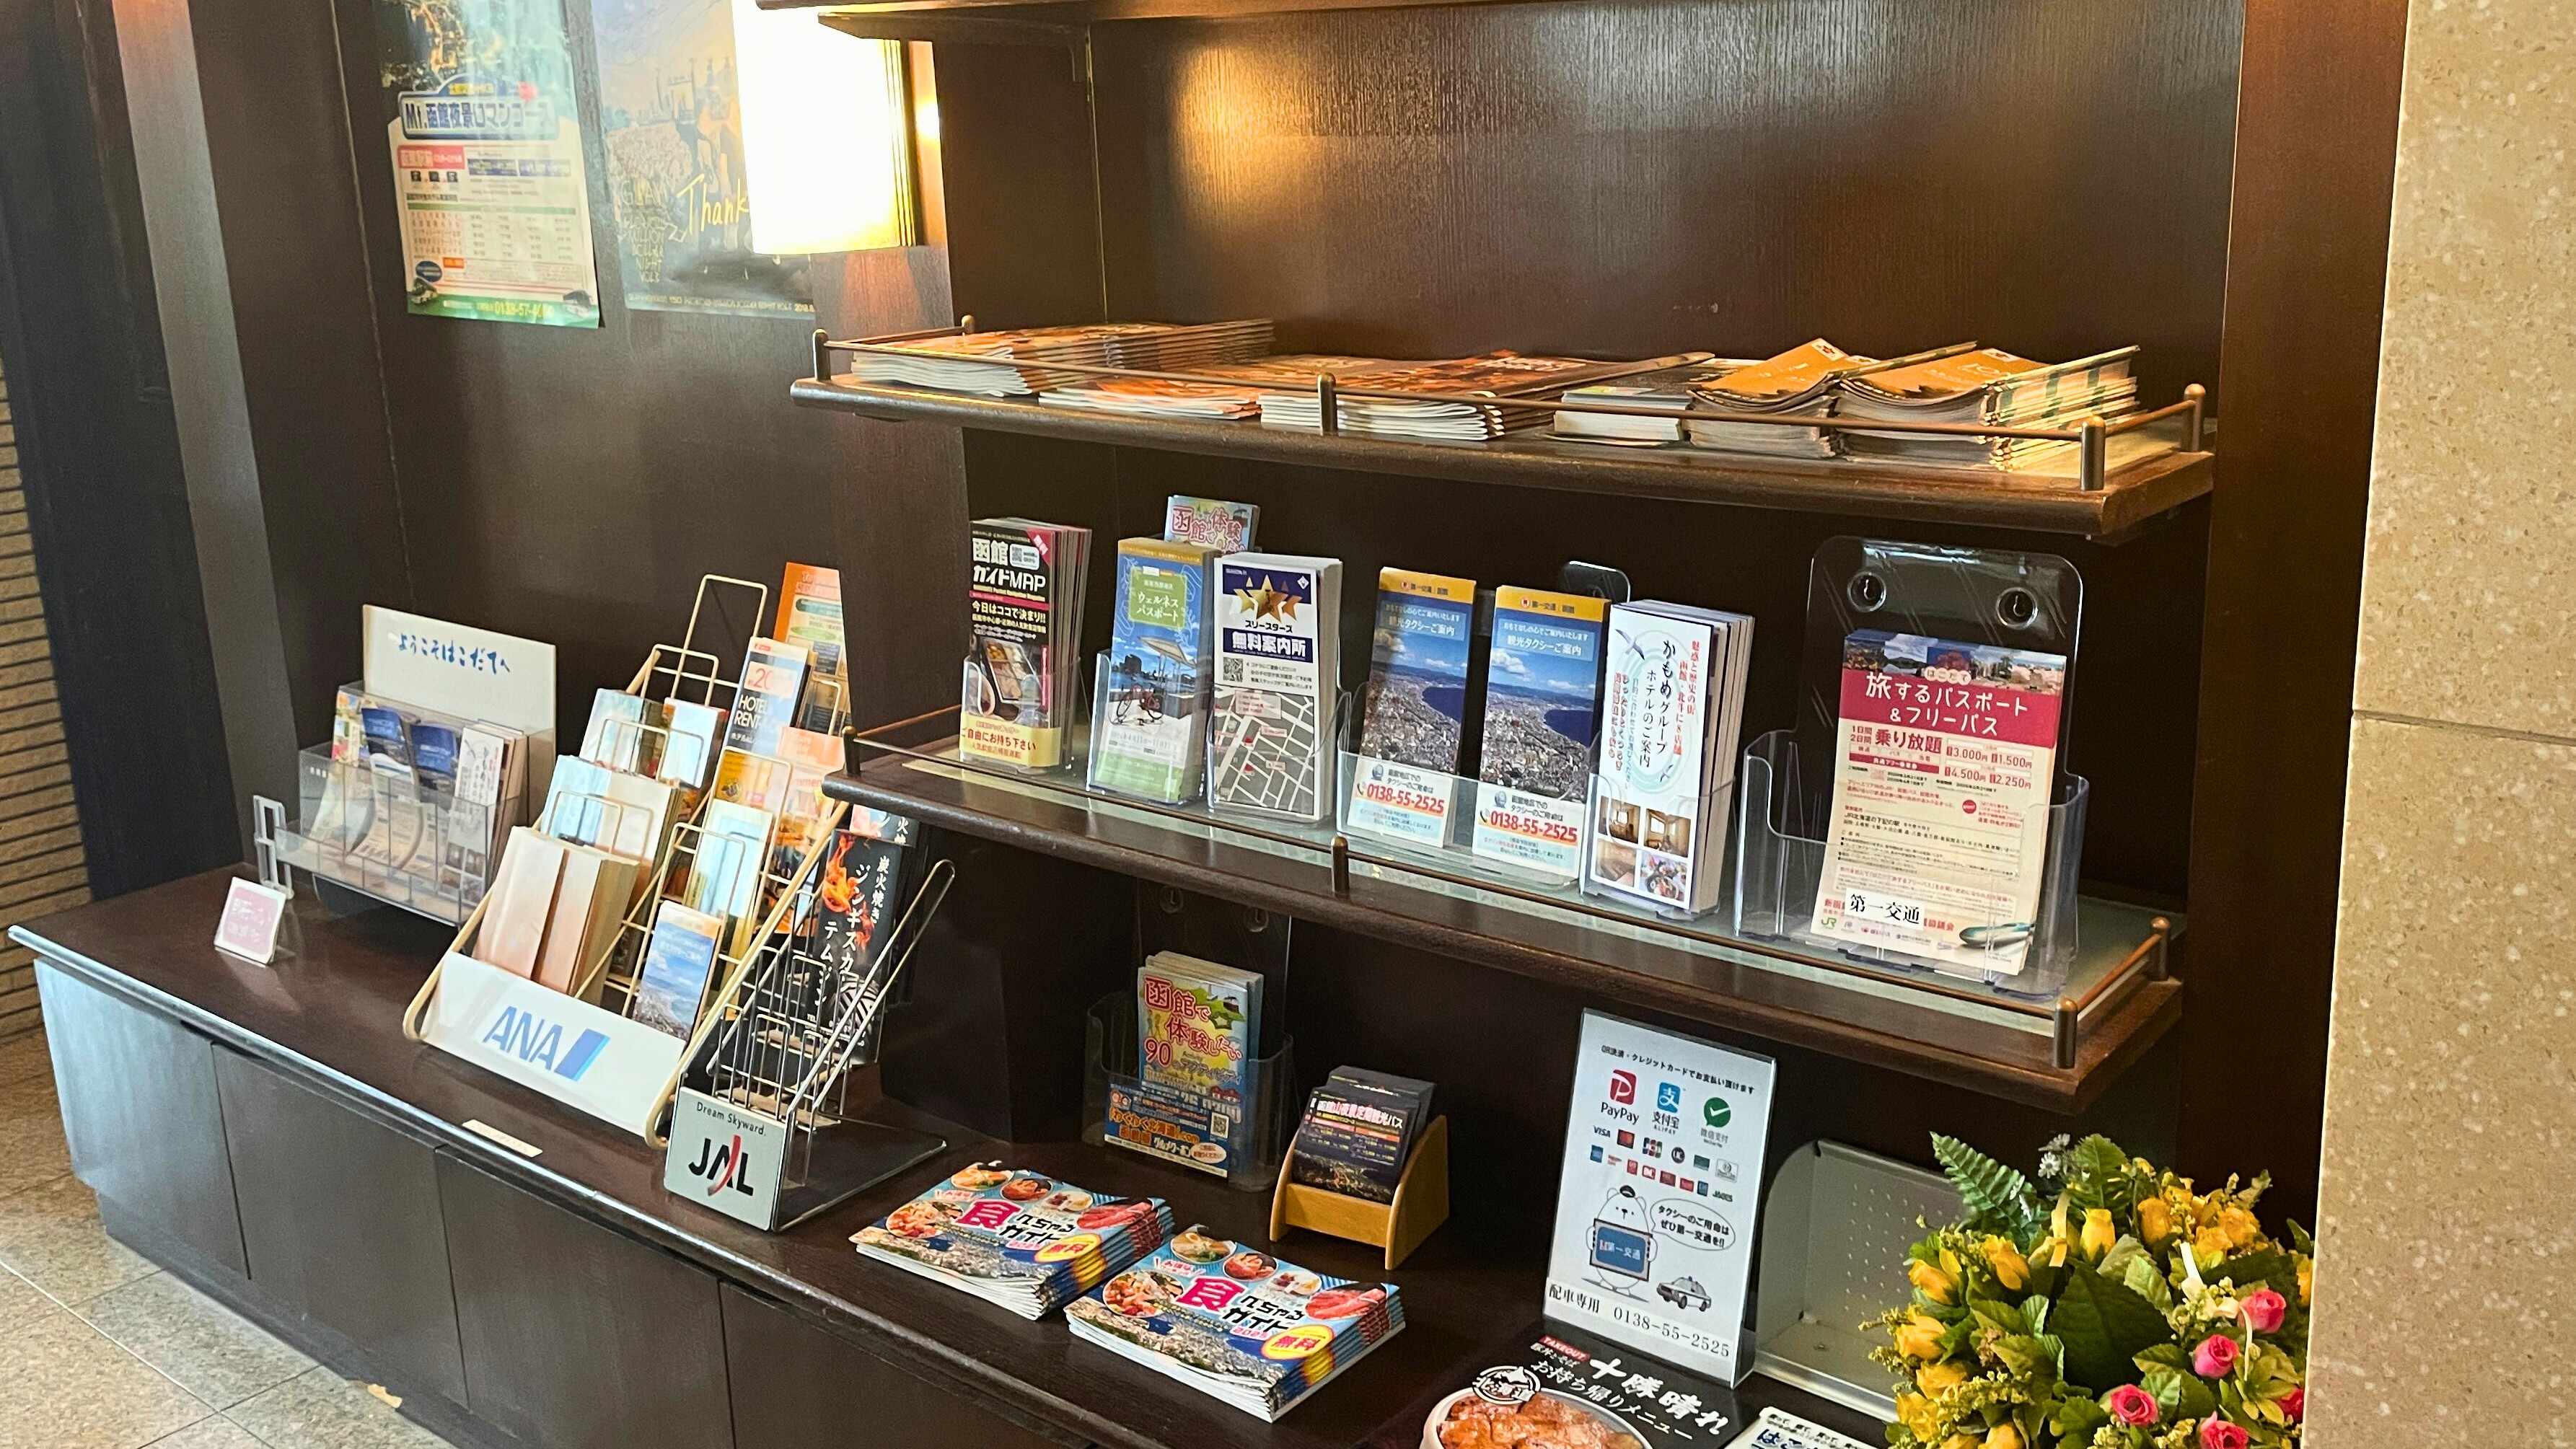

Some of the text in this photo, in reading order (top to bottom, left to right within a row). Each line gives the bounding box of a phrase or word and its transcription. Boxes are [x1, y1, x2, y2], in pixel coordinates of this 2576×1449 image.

[972, 537, 1008, 566] 函館
[973, 565, 1046, 592] ガイドMAP
[1137, 591, 1179, 608] ウェルネス
[1136, 607, 1179, 622] パスポート
[1245, 620, 1293, 633] スリースターズ
[1389, 615, 1455, 637] 観光タクシーご案内
[398, 633, 511, 675] ようこそはこだてへ
[1231, 631, 1306, 657] 無料案内所
[1507, 635, 1582, 656] 観光タクシーご案内
[1656, 639, 1676, 754] かもめグループ
[1865, 671, 2028, 717] 旅するパスポート
[1640, 669, 1657, 768] ホテルのご案内
[1889, 707, 1998, 736] &フリーパス
[961, 727, 1037, 752] ご自由にお持ち下さい
[1875, 728, 1943, 754] 乗り放題
[1366, 783, 1445, 814] 0138-55-2525
[1490, 810, 1578, 843] 0138-55-2525
[870, 855, 890, 925] 炭火焼き
[1850, 893, 1920, 926] 第一交通
[838, 863, 871, 994] ジンギスカン
[1143, 975, 1211, 1022] 函館で
[483, 1005, 560, 1075] ANA
[1143, 1036, 1174, 1068] 90
[696, 1101, 725, 1120] Dream
[1601, 1101, 1640, 1126] PayPay
[1651, 1110, 1680, 1130] 支付宝
[1593, 1124, 1612, 1138] VISA
[687, 1134, 755, 1197] JAL
[1549, 1283, 1730, 1358] 配車専用 0138-55-2525
[1543, 1335, 1588, 1360] TAKEOUT
[1472, 1376, 1537, 1402] 北海道
[1530, 1360, 1694, 1440] お持ち帰りメニュー
